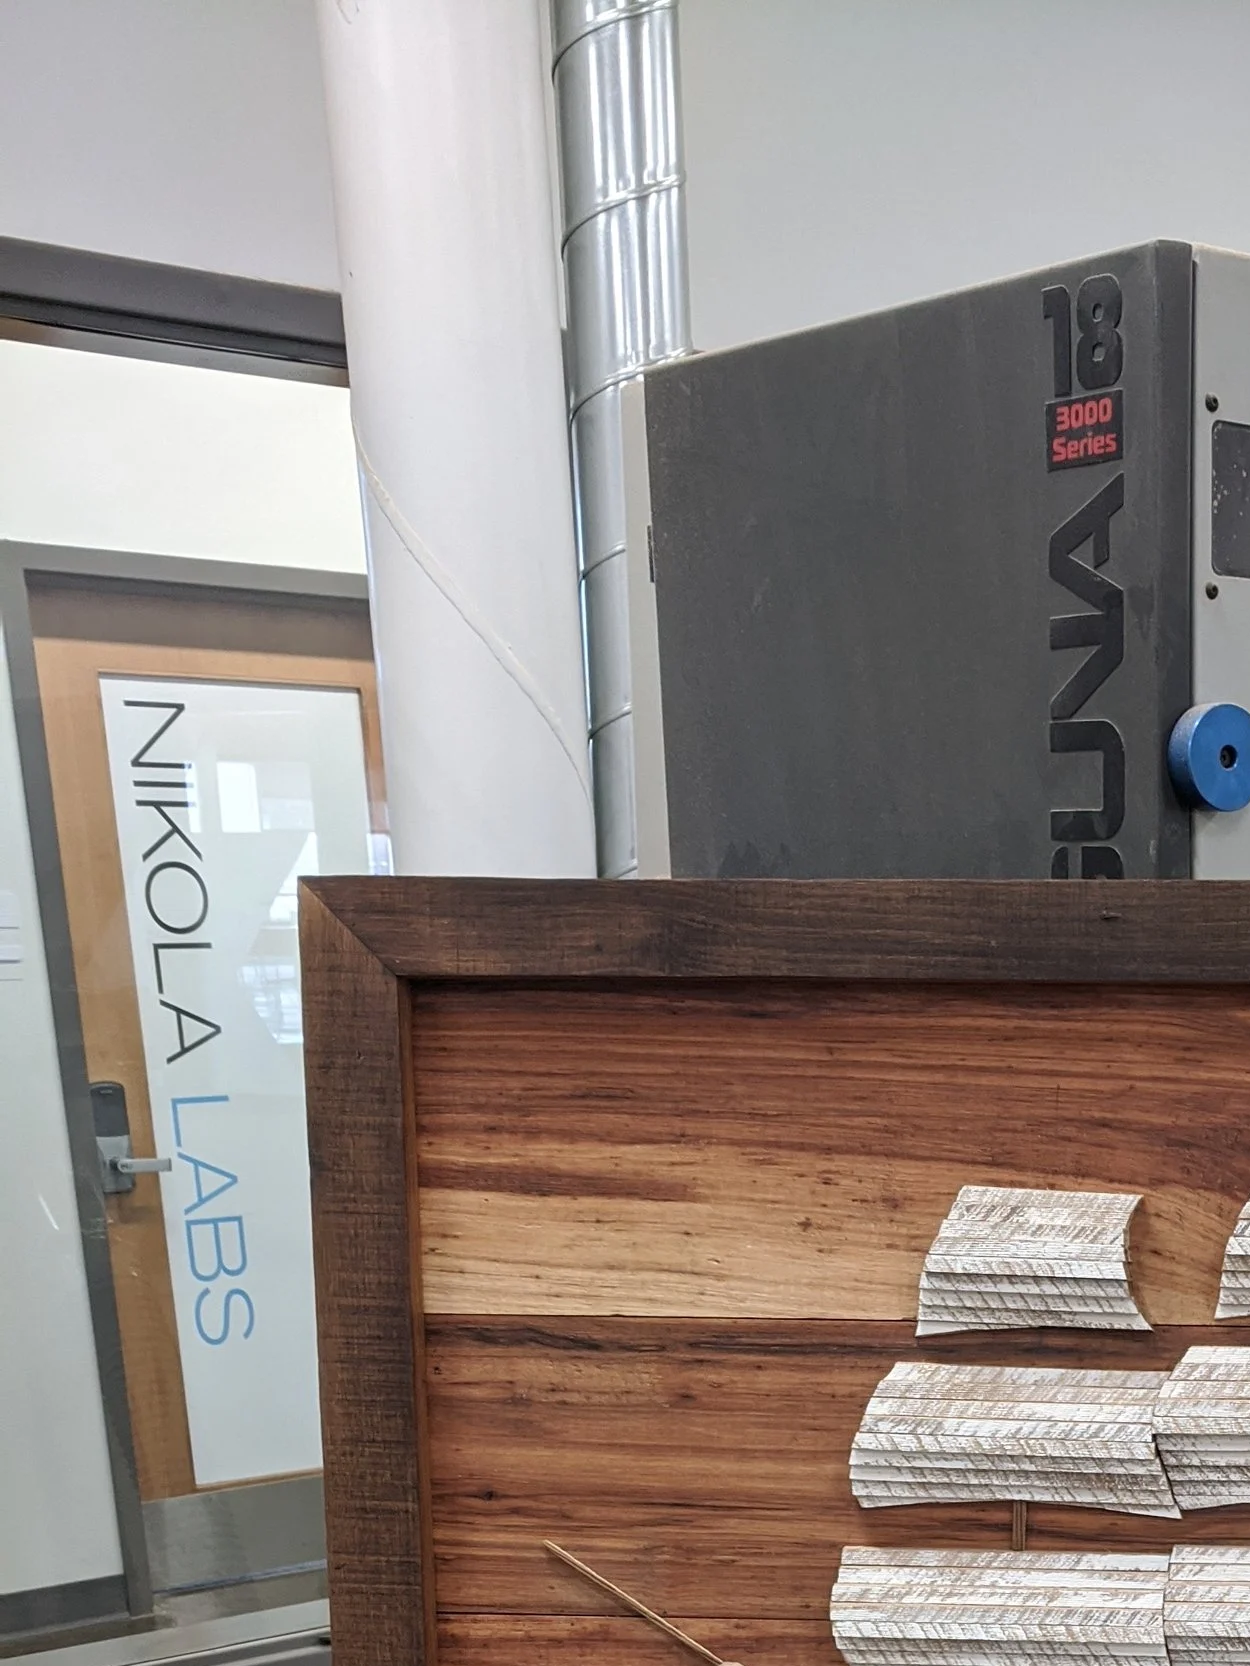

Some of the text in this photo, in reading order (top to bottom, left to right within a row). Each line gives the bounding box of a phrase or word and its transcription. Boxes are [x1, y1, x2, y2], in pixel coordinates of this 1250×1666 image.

[1041, 273, 1124, 397] 18
[1052, 432, 1117, 463] Series
[1056, 397, 1113, 432] 3000
[123, 700, 255, 1345] NIKOLA LABS
